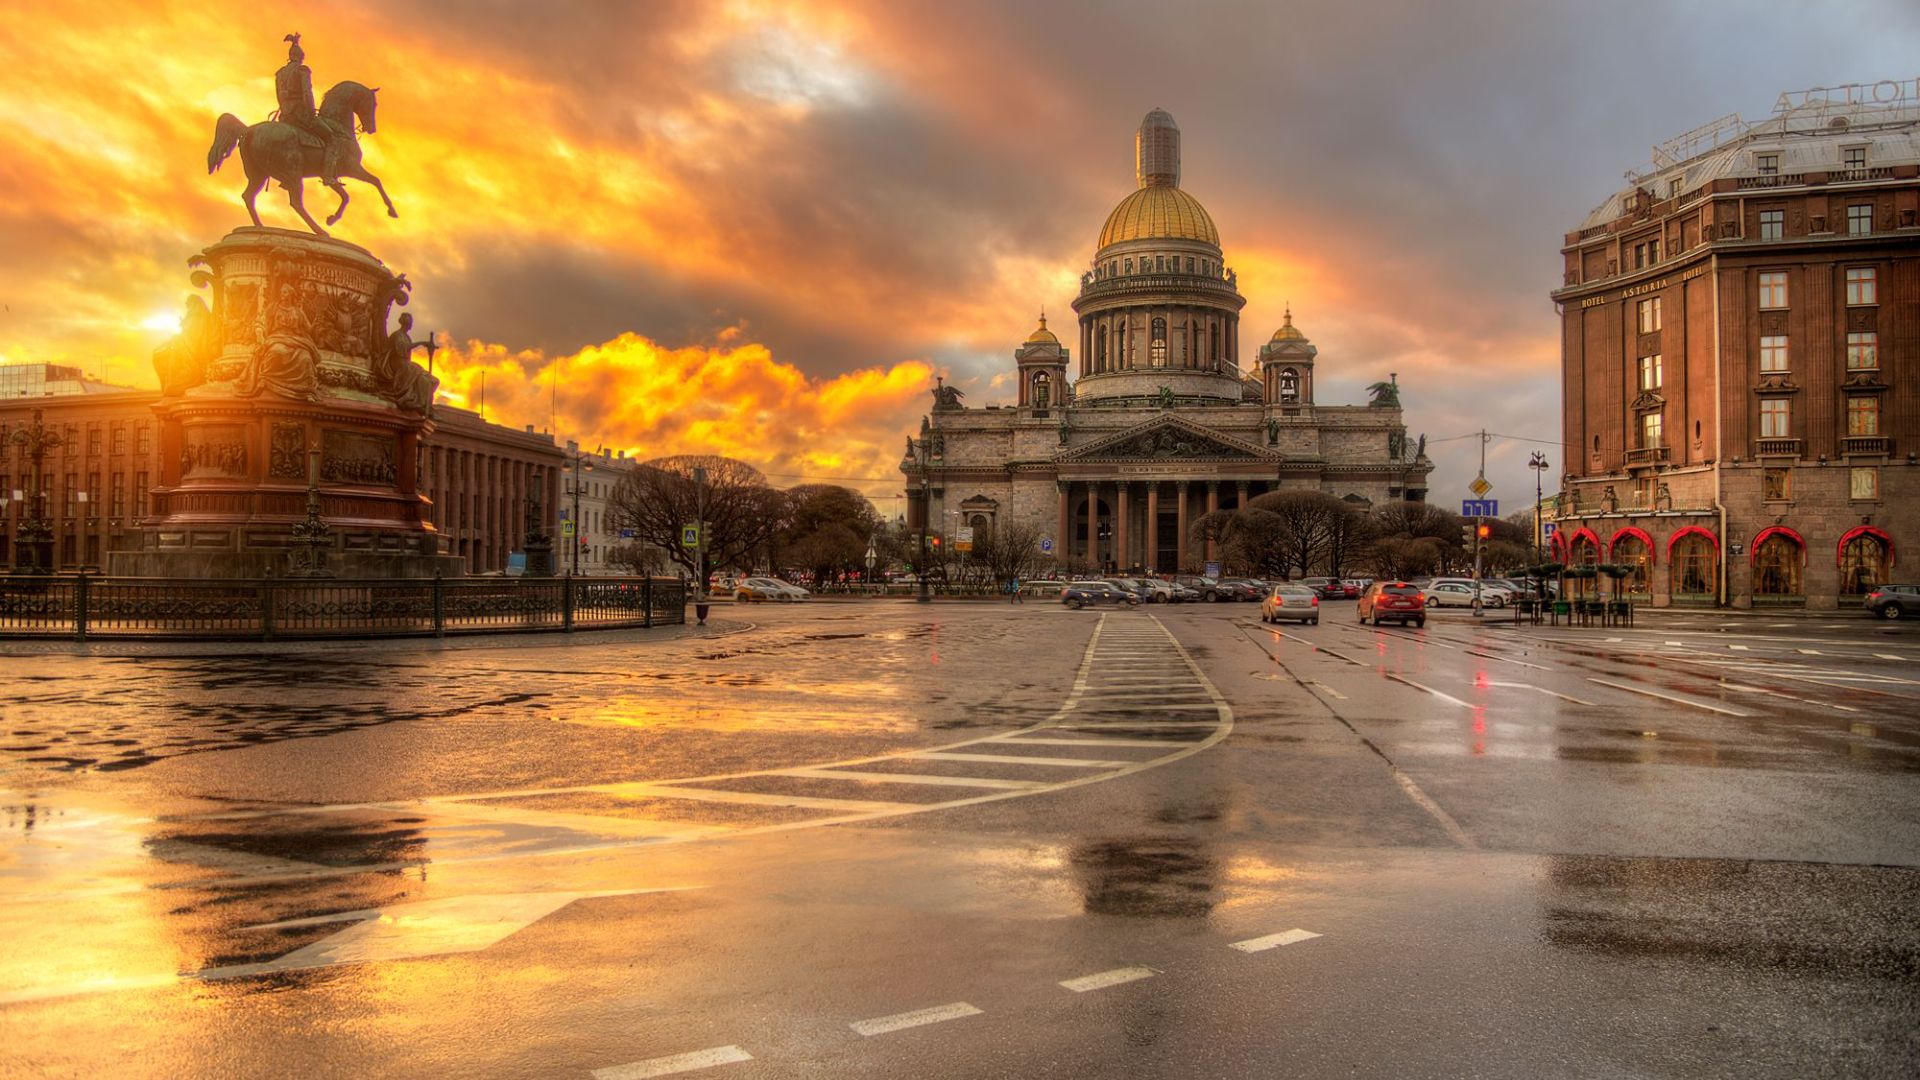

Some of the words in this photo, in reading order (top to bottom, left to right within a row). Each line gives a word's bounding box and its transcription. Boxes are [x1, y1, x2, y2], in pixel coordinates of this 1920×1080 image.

[1581, 295, 1605, 308] HOTEL
[1622, 279, 1669, 299] ASTORIA
[1682, 266, 1704, 281] HOTEL
